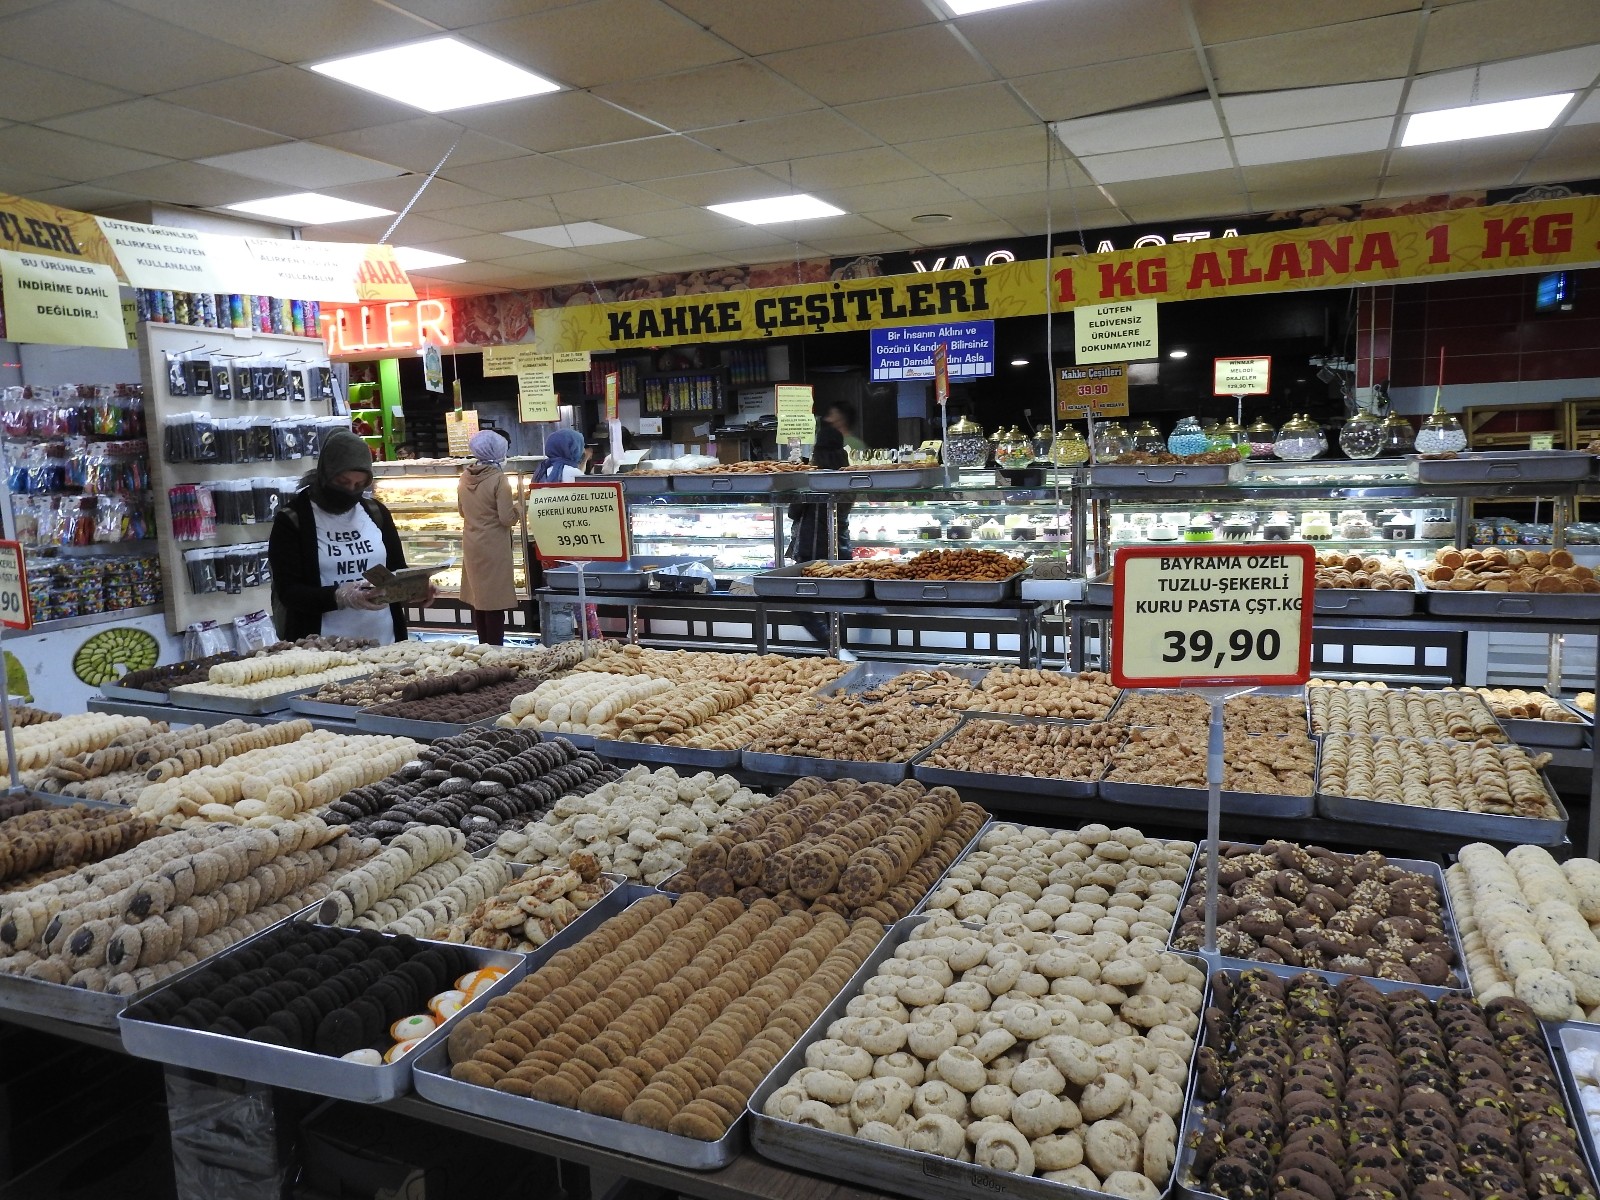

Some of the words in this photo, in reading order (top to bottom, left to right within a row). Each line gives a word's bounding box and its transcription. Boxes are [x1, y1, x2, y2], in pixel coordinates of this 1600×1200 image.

[103, 221, 145, 233] LÜTFEN
[147, 226, 199, 240] ÜRÜNLERİ
[115, 239, 161, 251] ALIRKEN
[164, 245, 206, 257] ELDİVEN
[21, 258, 38, 268] BU
[41, 259, 96, 275] ÜRÜNLER
[136, 258, 203, 273] KULLANALIM
[607, 301, 742, 342] KAHKE
[754, 268, 990, 337] ÇEŞİTLERİ
[1054, 267, 1076, 303] 1
[1098, 257, 1168, 299] KG
[1186, 230, 1399, 291] ALANA
[1425, 224, 1451, 264] 1
[1482, 211, 1574, 259] KG
[18, 277, 73, 294] İNDİRİME
[76, 285, 109, 298] DAHİL
[37, 305, 99, 319] DEĞİLDİR.!
[1097, 305, 1133, 316] LÜTFEN
[1088, 316, 1142, 328] ELDİVENSİZ
[887, 330, 901, 341] Bir
[903, 328, 936, 340] İnsanın
[938, 326, 963, 337] Aklını
[965, 327, 977, 336] ve
[1091, 328, 1140, 340] ÜRÜNLERE
[876, 343, 911, 355] Gözünü
[951, 339, 989, 351] Bilirsiniz
[1081, 339, 1152, 353] DOKUNMAYINIZ
[879, 358, 900, 368] Ama
[903, 355, 934, 367] Damak
[964, 352, 985, 363] Asla
[1061, 368, 1087, 380] Kahke
[1088, 366, 1123, 380] Çeşitleri
[1078, 384, 1109, 397] 39.90
[1060, 400, 1066, 411] 1
[1092, 399, 1097, 409] 1
[534, 495, 570, 505] BAYRAMA
[570, 492, 589, 502] ÖZEL
[590, 491, 617, 500] TUZLU-
[537, 507, 565, 519] ŞEKERLİ
[566, 506, 588, 515] KURU
[589, 504, 614, 514] PASTA
[327, 543, 342, 557] IS
[345, 539, 374, 556] THE
[557, 534, 589, 548] 39,90
[590, 533, 606, 545] TL
[337, 558, 369, 576] NEW
[1159, 556, 1242, 571] BAYRAMA
[1158, 573, 1290, 594] TUZLU-ŞEKERLİ
[1136, 599, 1183, 614] KURU
[1188, 598, 1241, 613] PASTA
[1245, 597, 1304, 615] ÇŞT.KG
[1162, 628, 1281, 669] 39,90
[973, 1174, 1007, 1193] 1200gr
